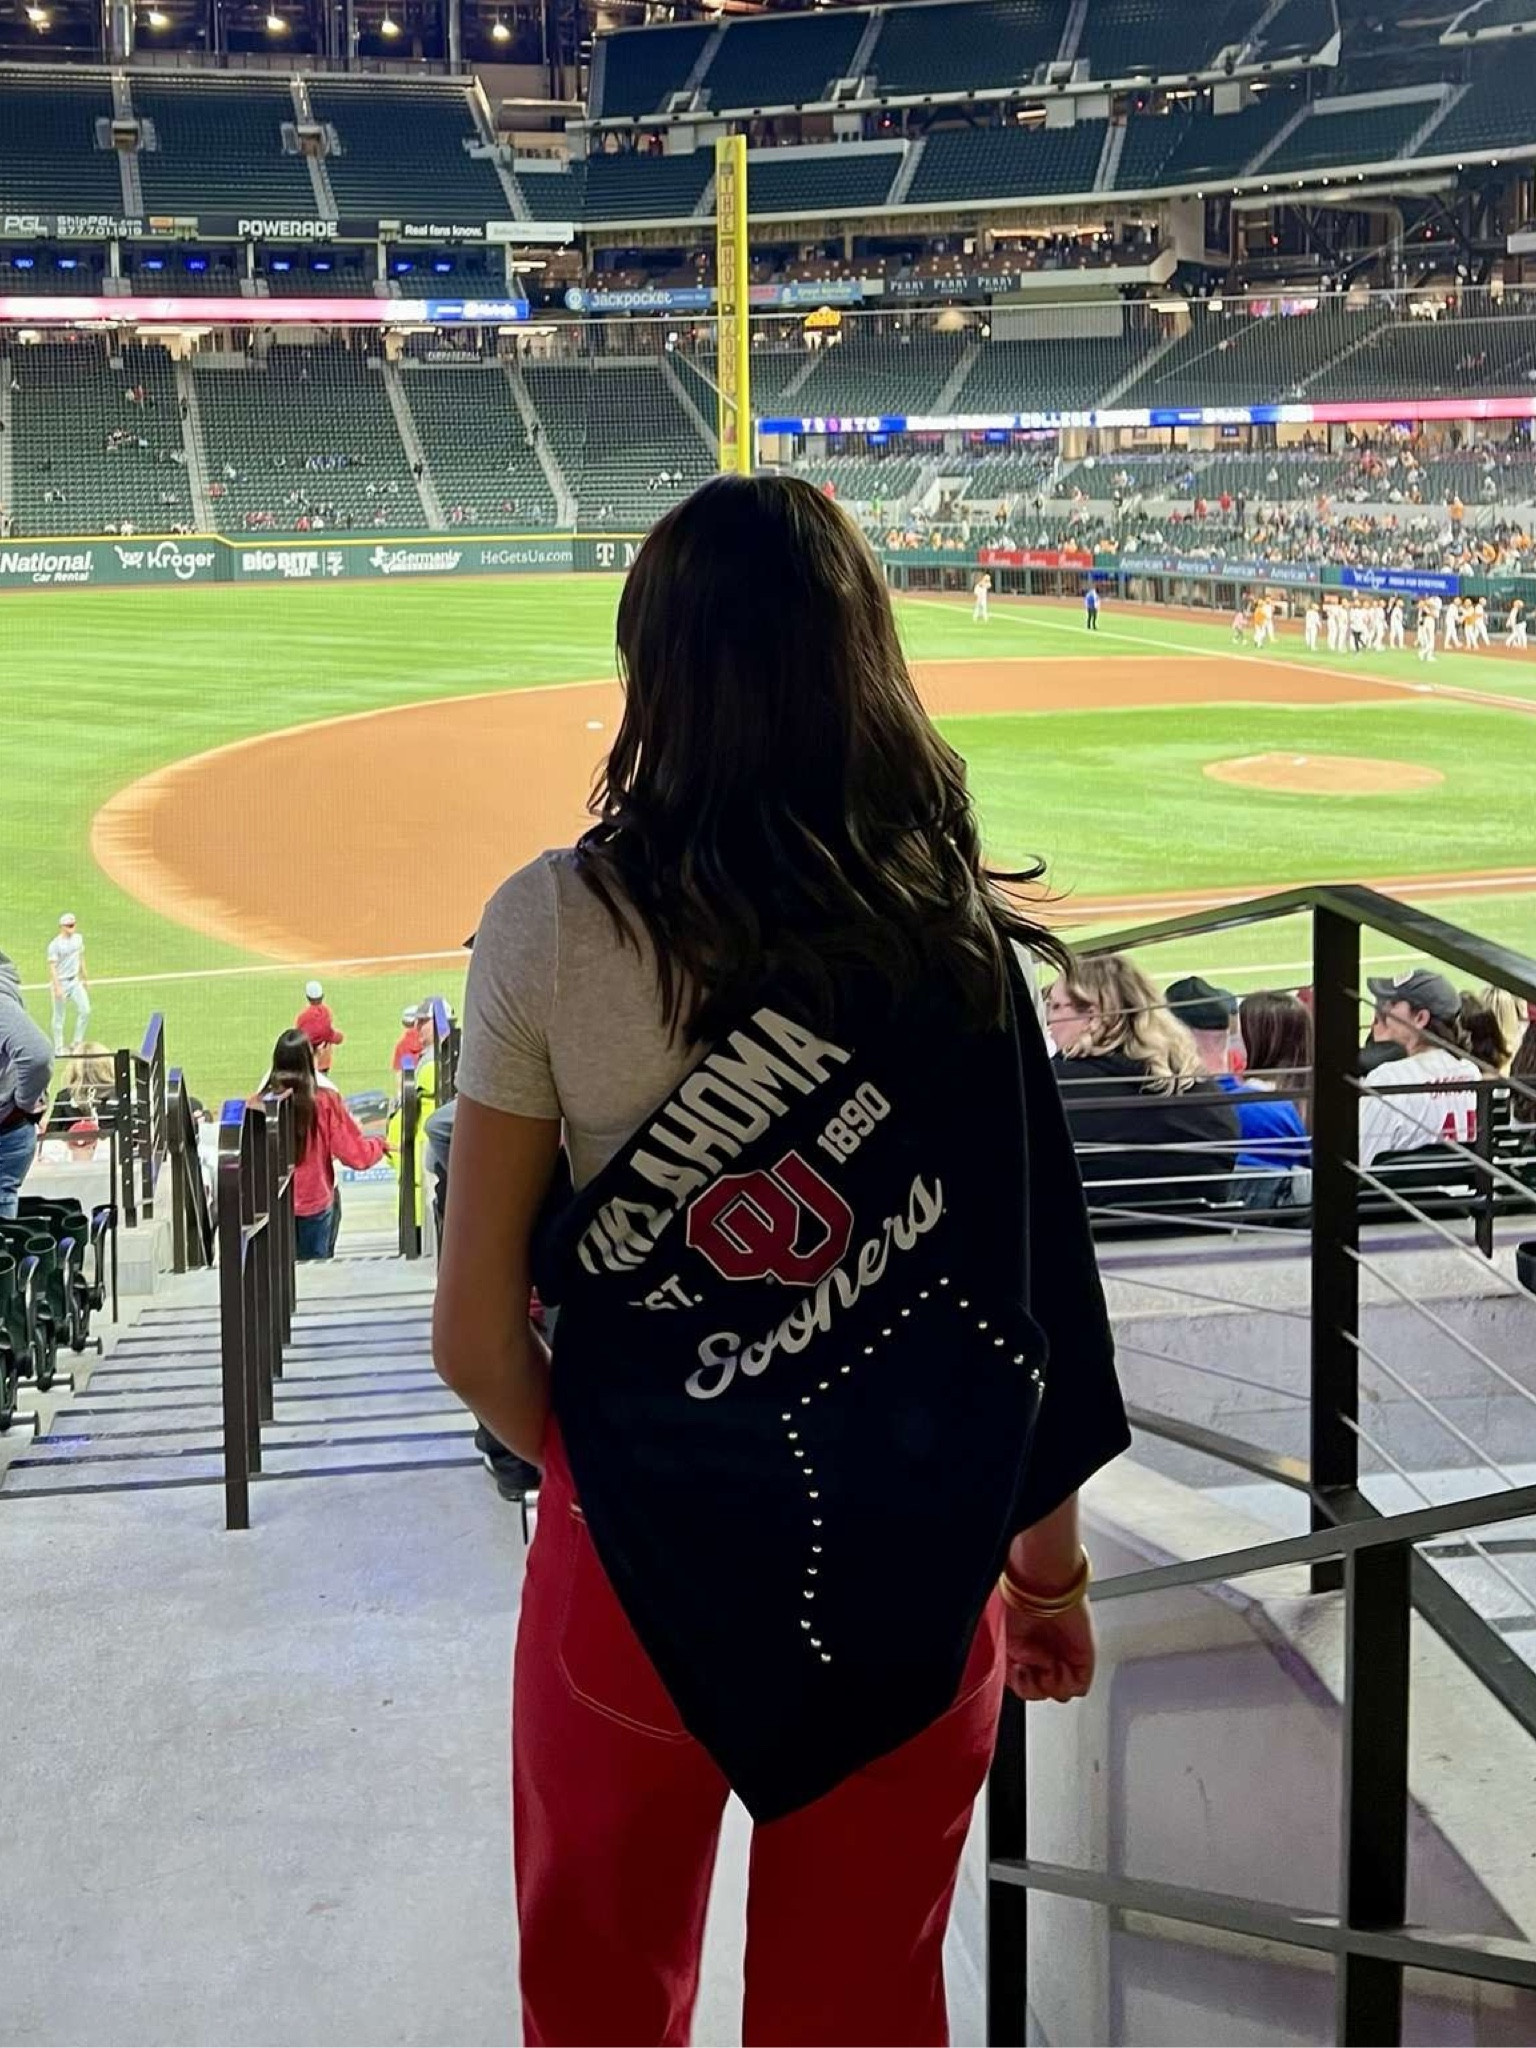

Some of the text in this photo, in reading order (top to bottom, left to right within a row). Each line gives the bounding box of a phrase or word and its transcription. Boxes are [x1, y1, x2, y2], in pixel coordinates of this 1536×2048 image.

[4, 216, 48, 234] PGL
[238, 220, 338, 236] POWERADE
[405, 224, 428, 236] Real
[429, 224, 450, 236] fans
[147, 541, 215, 579] Kroger
[481, 550, 573, 565] HeGetsUs.com
[32, 571, 89, 582] Car Rental
[816, 1081, 891, 1164] 1890
[684, 1174, 943, 1399] Sooners
